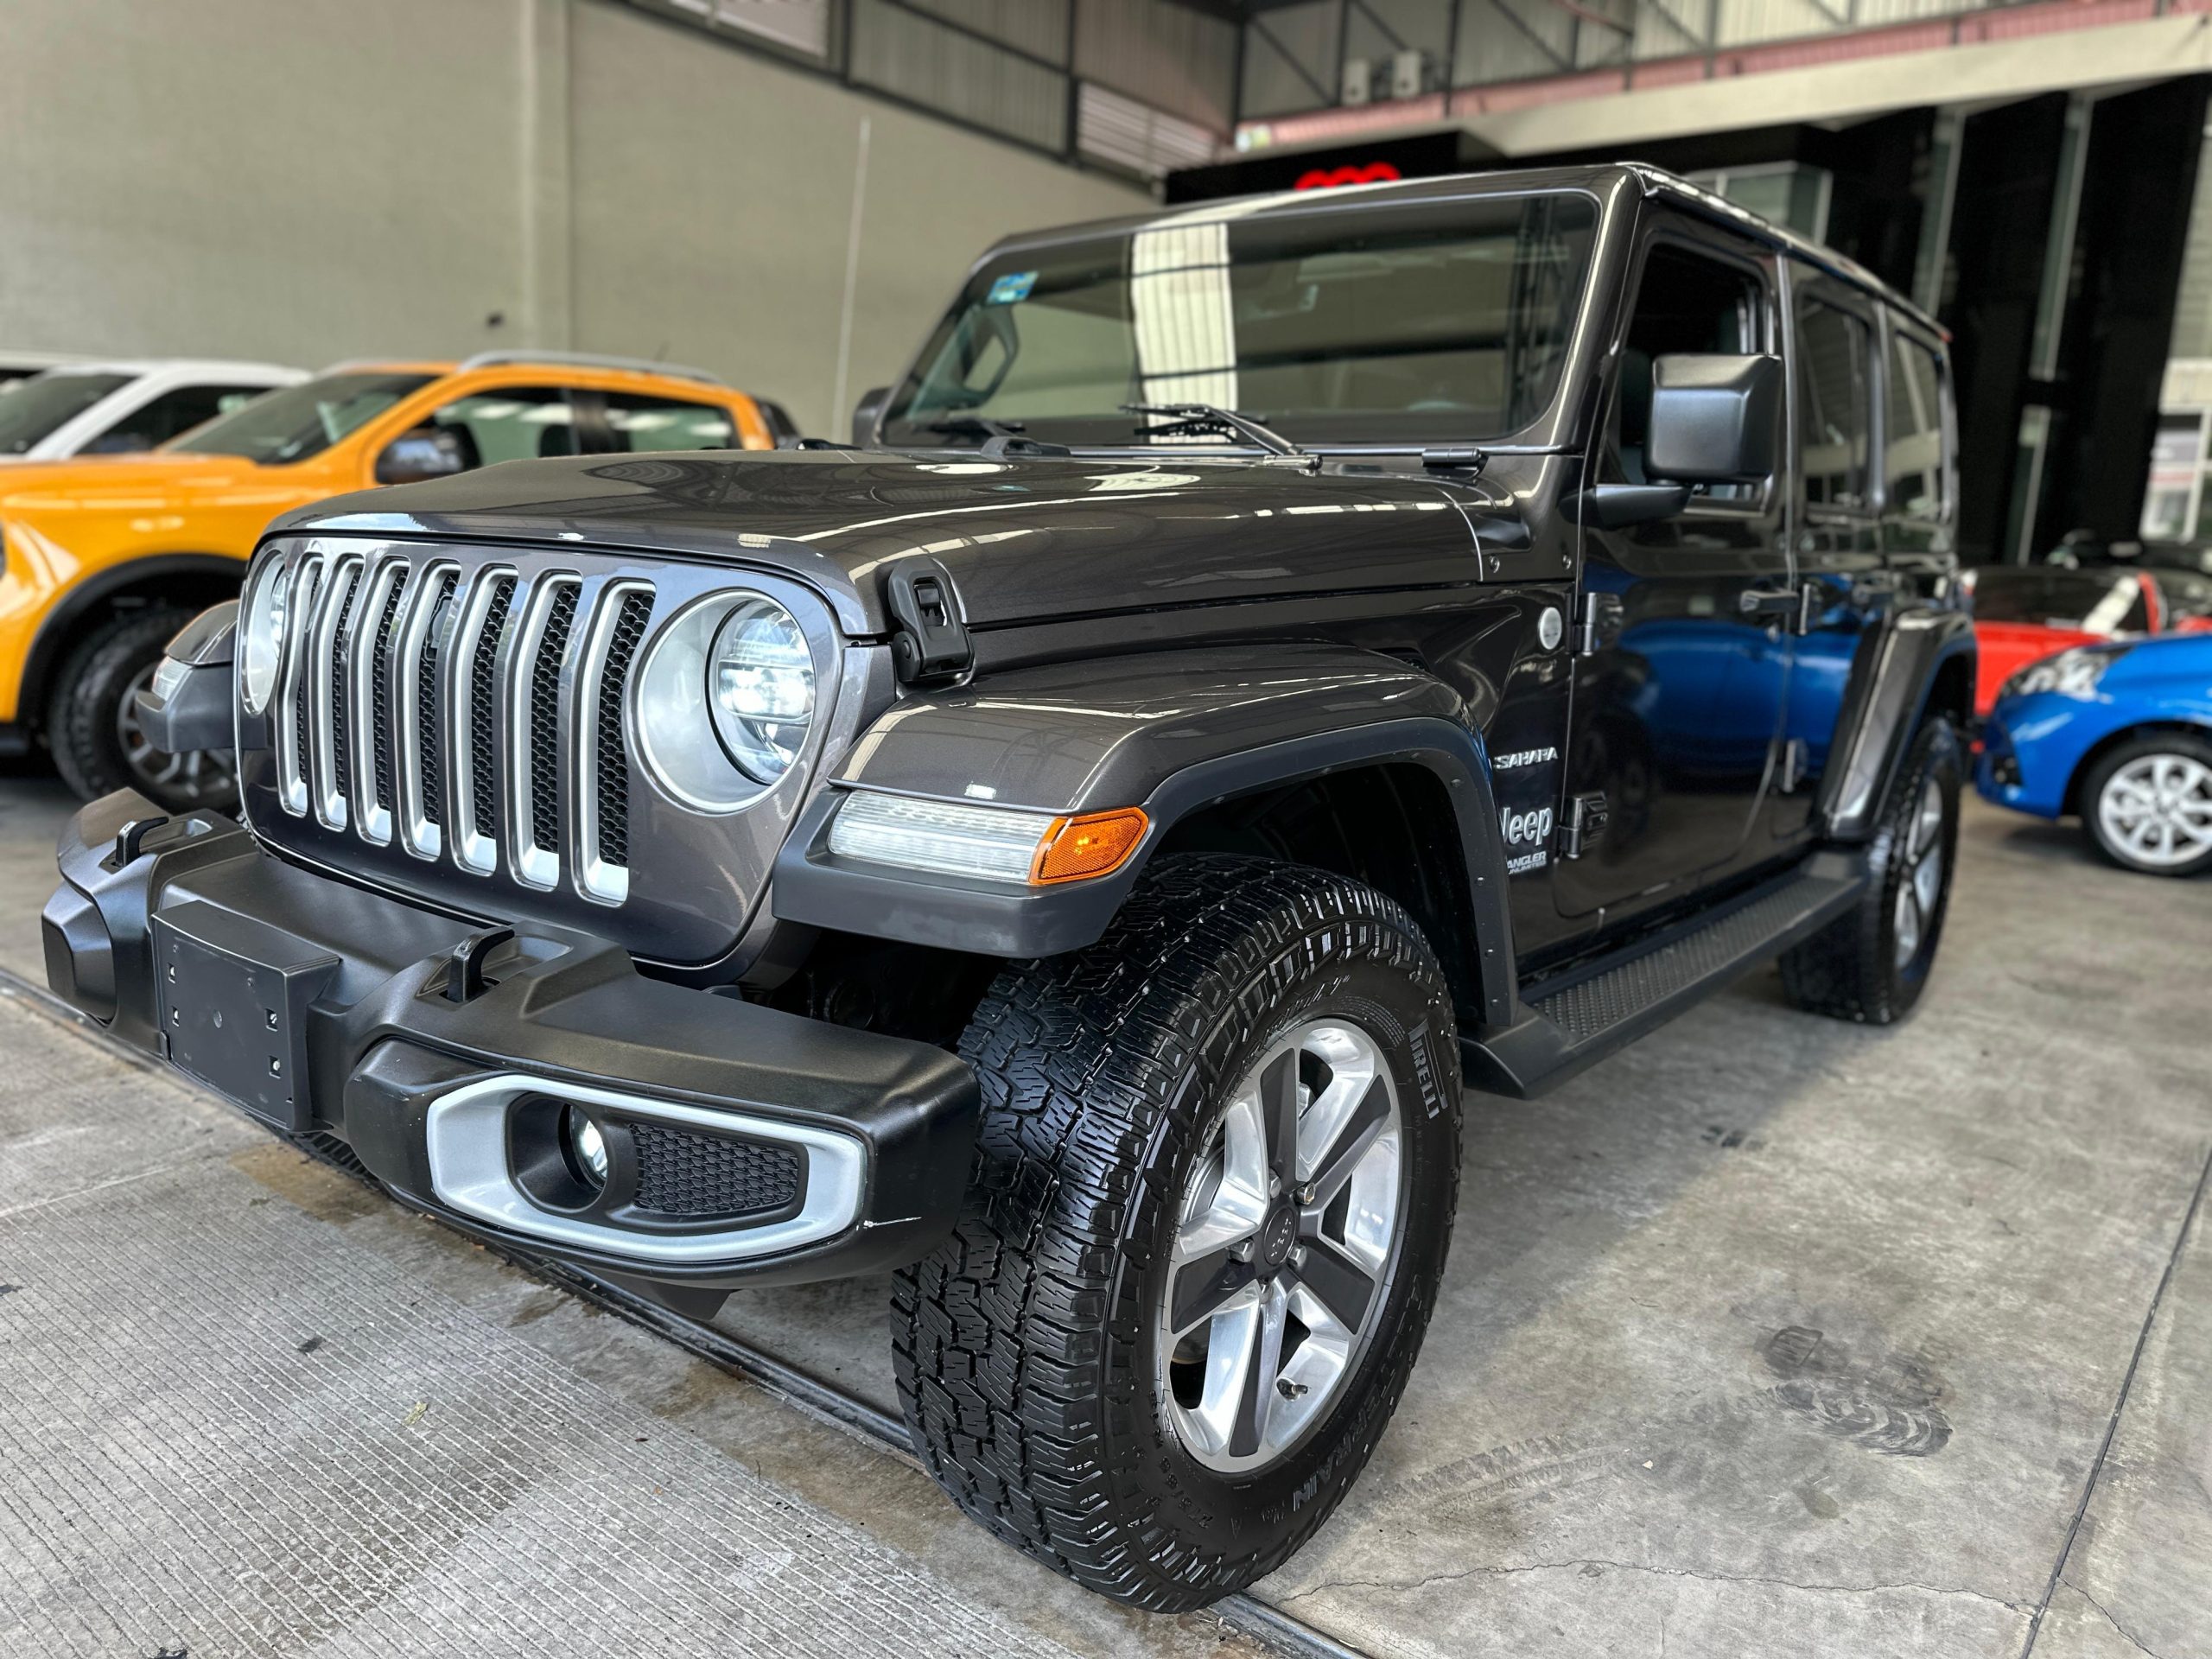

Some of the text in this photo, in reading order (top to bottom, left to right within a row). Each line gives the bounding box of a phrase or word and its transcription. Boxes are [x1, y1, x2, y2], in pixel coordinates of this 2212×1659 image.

[1494, 747, 1558, 769] SAHARA
[1499, 807, 1553, 846] Jeep
[1408, 1018, 1448, 1120] PIRELLI
